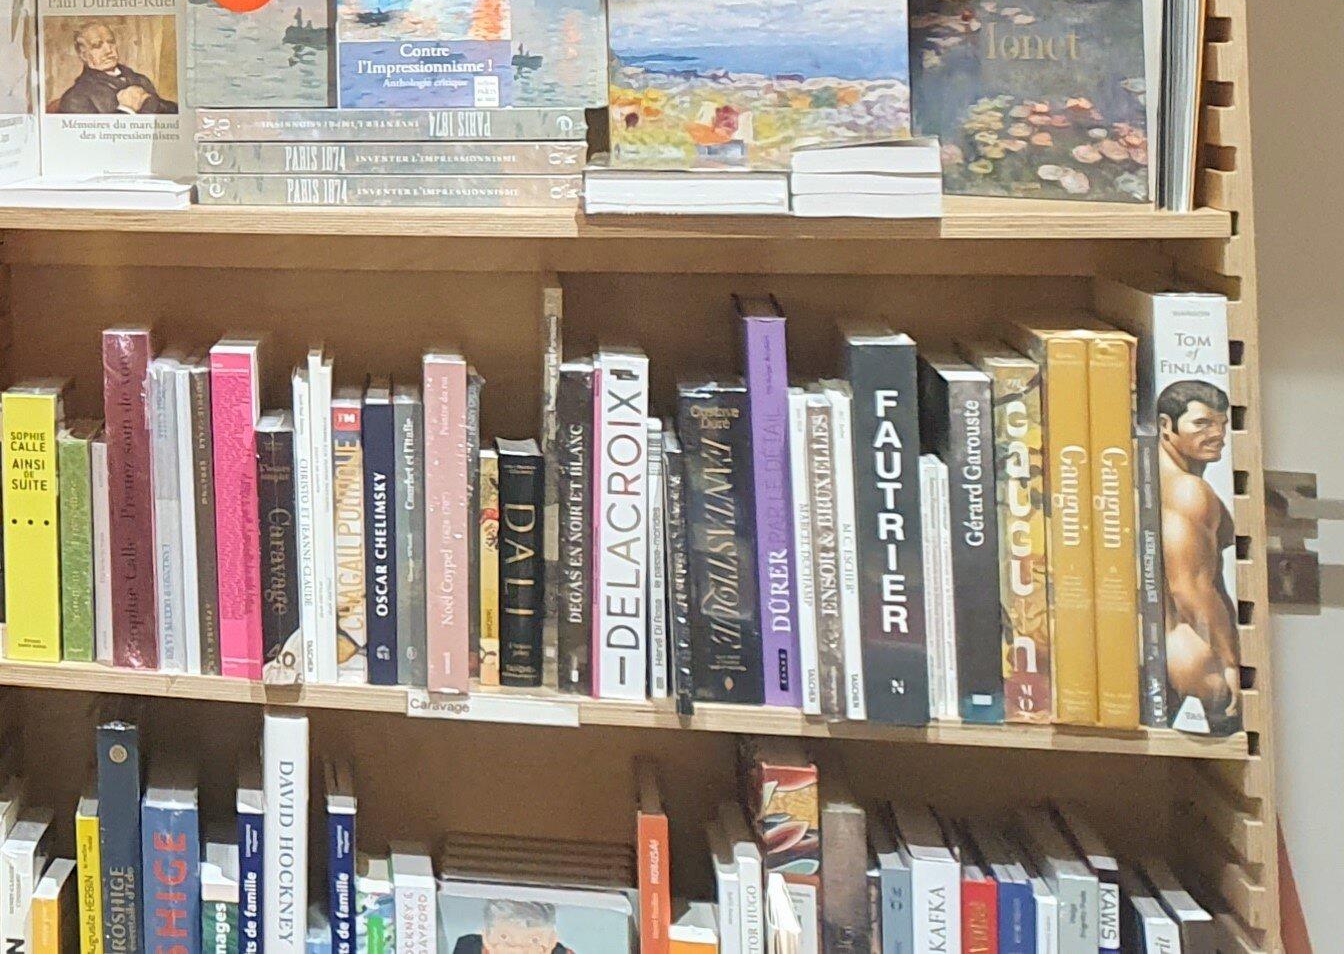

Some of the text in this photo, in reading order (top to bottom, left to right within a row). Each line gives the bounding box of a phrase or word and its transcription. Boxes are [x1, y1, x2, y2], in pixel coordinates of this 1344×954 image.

[358, 58, 484, 77] l'Impressionnisme
[399, 43, 450, 59] Contre
[382, 78, 431, 89] Anthologie
[62, 119, 180, 130] Mémoires du marchand
[80, 130, 97, 141] des
[428, 111, 492, 138] PARIS 1874
[285, 146, 346, 172] PARIS 1874
[286, 178, 348, 204] PARIS 1874
[1174, 332, 1211, 348] TOM
[1160, 359, 1228, 376] FINLAND
[10, 431, 47, 442] SOPHIE
[10, 441, 47, 453] CALLE
[11, 479, 49, 492] SUITE
[12, 457, 47, 471] AINSI
[23, 471, 36, 479] DE
[813, 414, 835, 528] BRUXELLES
[961, 399, 985, 547] Gérard Garouste
[606, 390, 642, 651] DELACROIX
[872, 389, 910, 635] FAUTRIER
[1052, 445, 1090, 547] Gauguin
[1092, 446, 1129, 549] Gauguin
[373, 471, 389, 617] OSCAR CHELIMSKY
[567, 424, 584, 623] DEGAS EN NOIR ET BLANC
[700, 437, 742, 649] FANTASTIQUE
[268, 506, 293, 615] Caravage
[820, 551, 839, 615] ENSOR
[439, 549, 458, 626] Noël Coypel
[767, 548, 792, 633] DÜRER
[409, 697, 470, 714] Caravage
[277, 760, 294, 946] DAVID HOCKNEY
[243, 871, 258, 936] de famille
[335, 872, 350, 940] de famille
[745, 884, 759, 924] HUGO
[927, 885, 947, 954] KAFKA
[1099, 888, 1119, 941] KAWS
